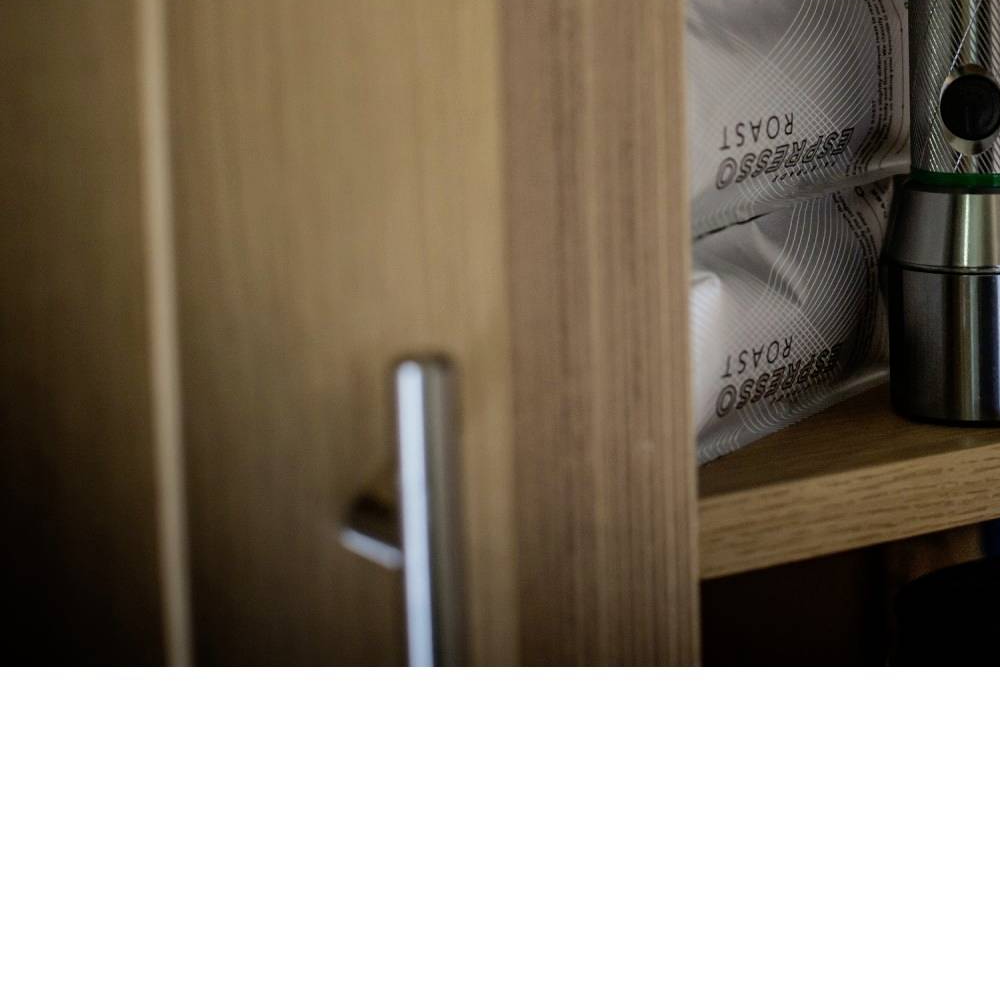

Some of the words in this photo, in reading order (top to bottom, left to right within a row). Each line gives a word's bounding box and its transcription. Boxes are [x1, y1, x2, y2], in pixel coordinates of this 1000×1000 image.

[720, 112, 794, 150] ROAST
[716, 127, 855, 190] ESPRESSO
[715, 342, 844, 418] ESPRESSO
[721, 336, 793, 378] ROAST
